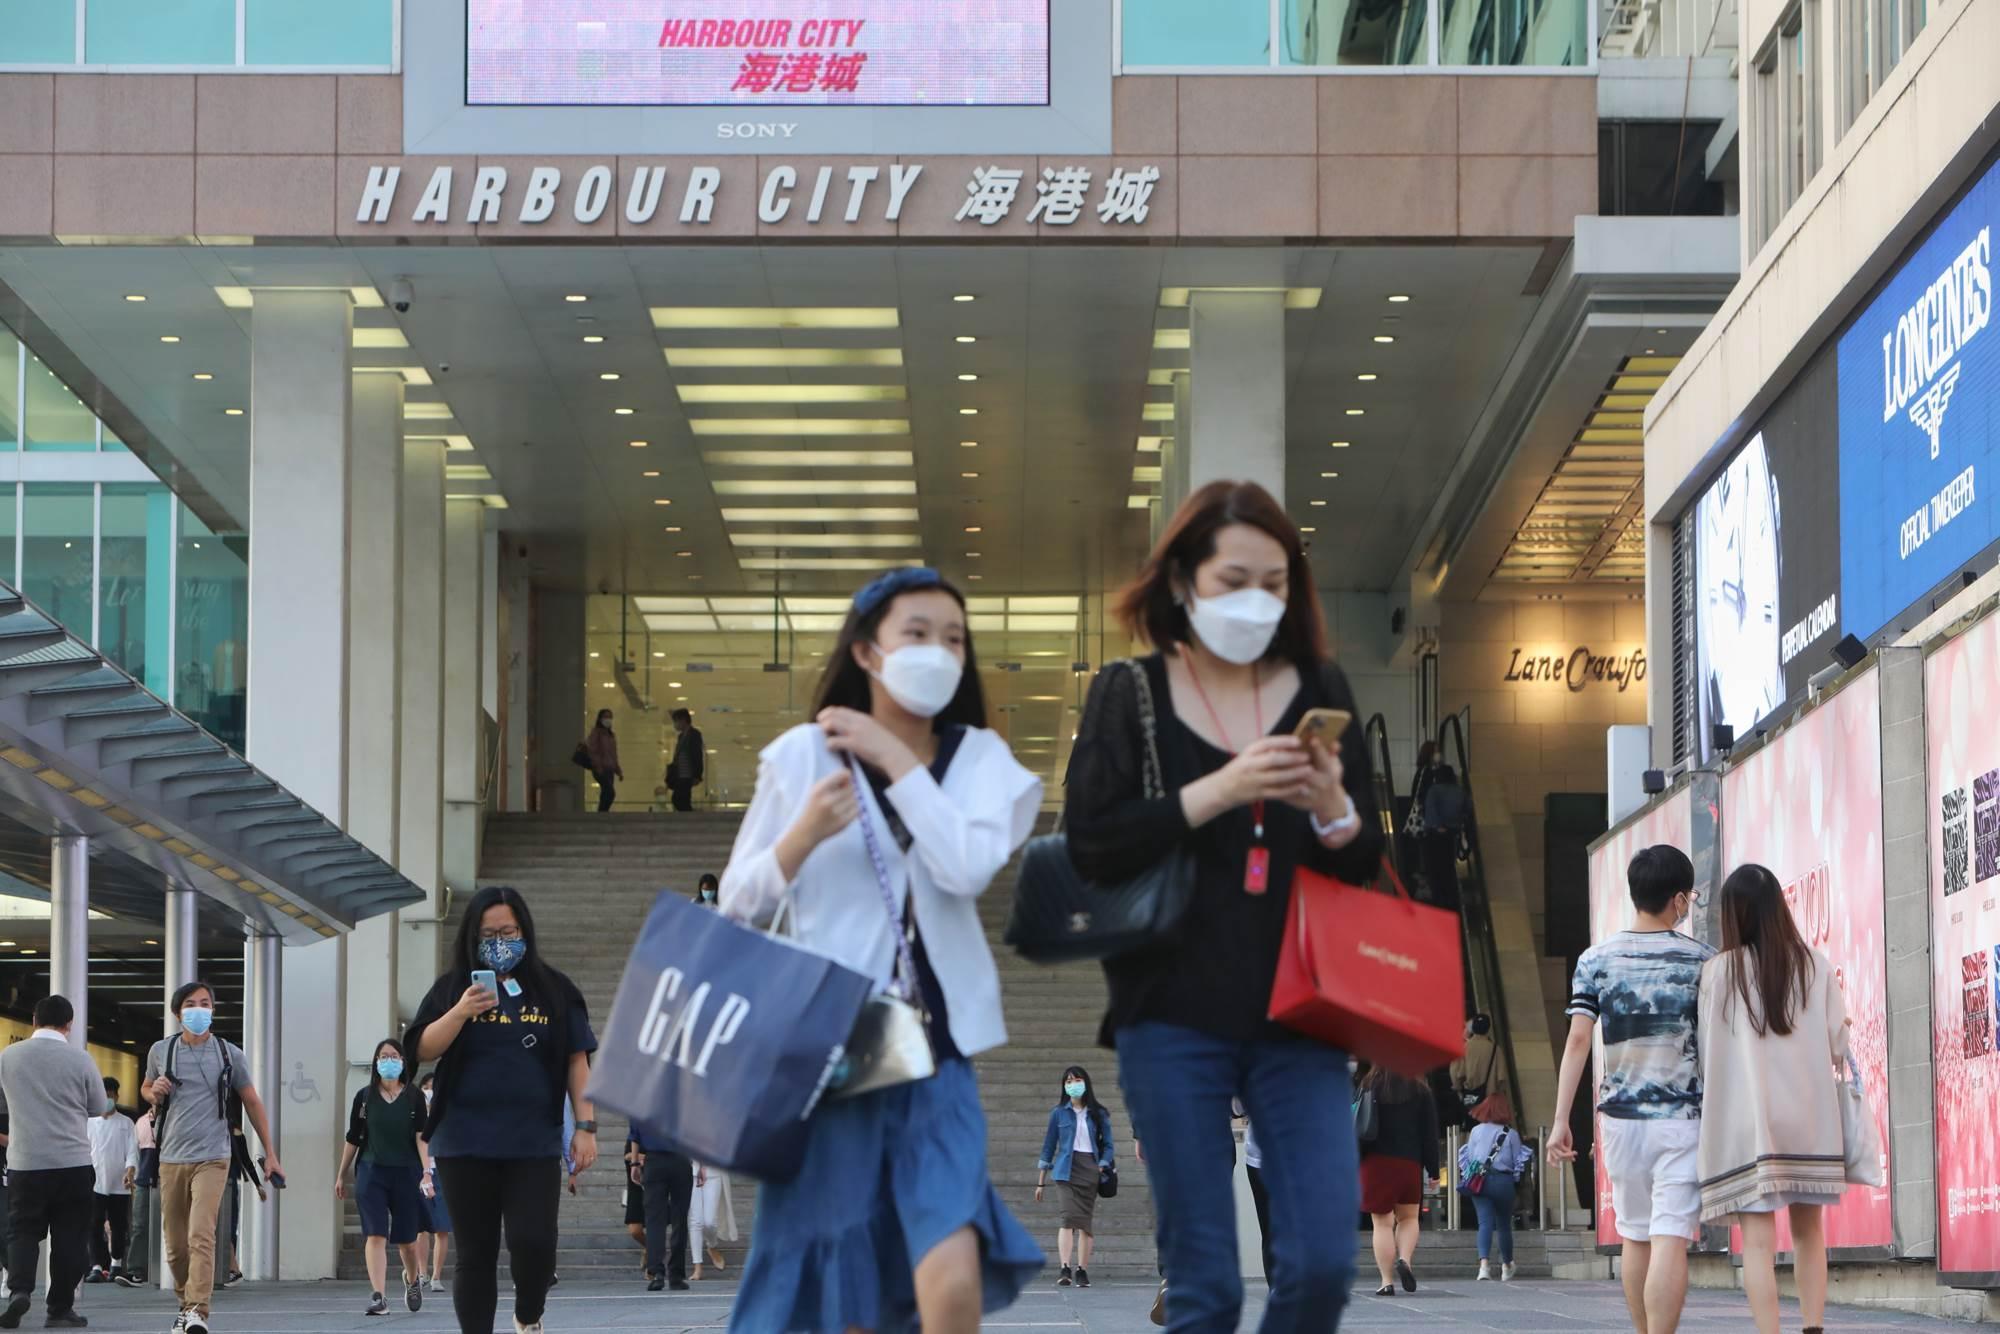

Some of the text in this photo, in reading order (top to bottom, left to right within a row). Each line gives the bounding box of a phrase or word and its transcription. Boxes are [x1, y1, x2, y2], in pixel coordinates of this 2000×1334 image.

[658, 19, 866, 47] HARBOUR CITY
[730, 52, 868, 93] 海港城
[717, 122, 798, 138] SONY
[355, 163, 924, 224] HARBOUR CITY
[954, 164, 1161, 225] 海港城
[1883, 225, 1992, 423] LONGINES
[1900, 464, 1976, 561] OFFICIAL TIMEKEEPER
[1503, 648, 1565, 681] Lane
[638, 966, 751, 1078] GAP
